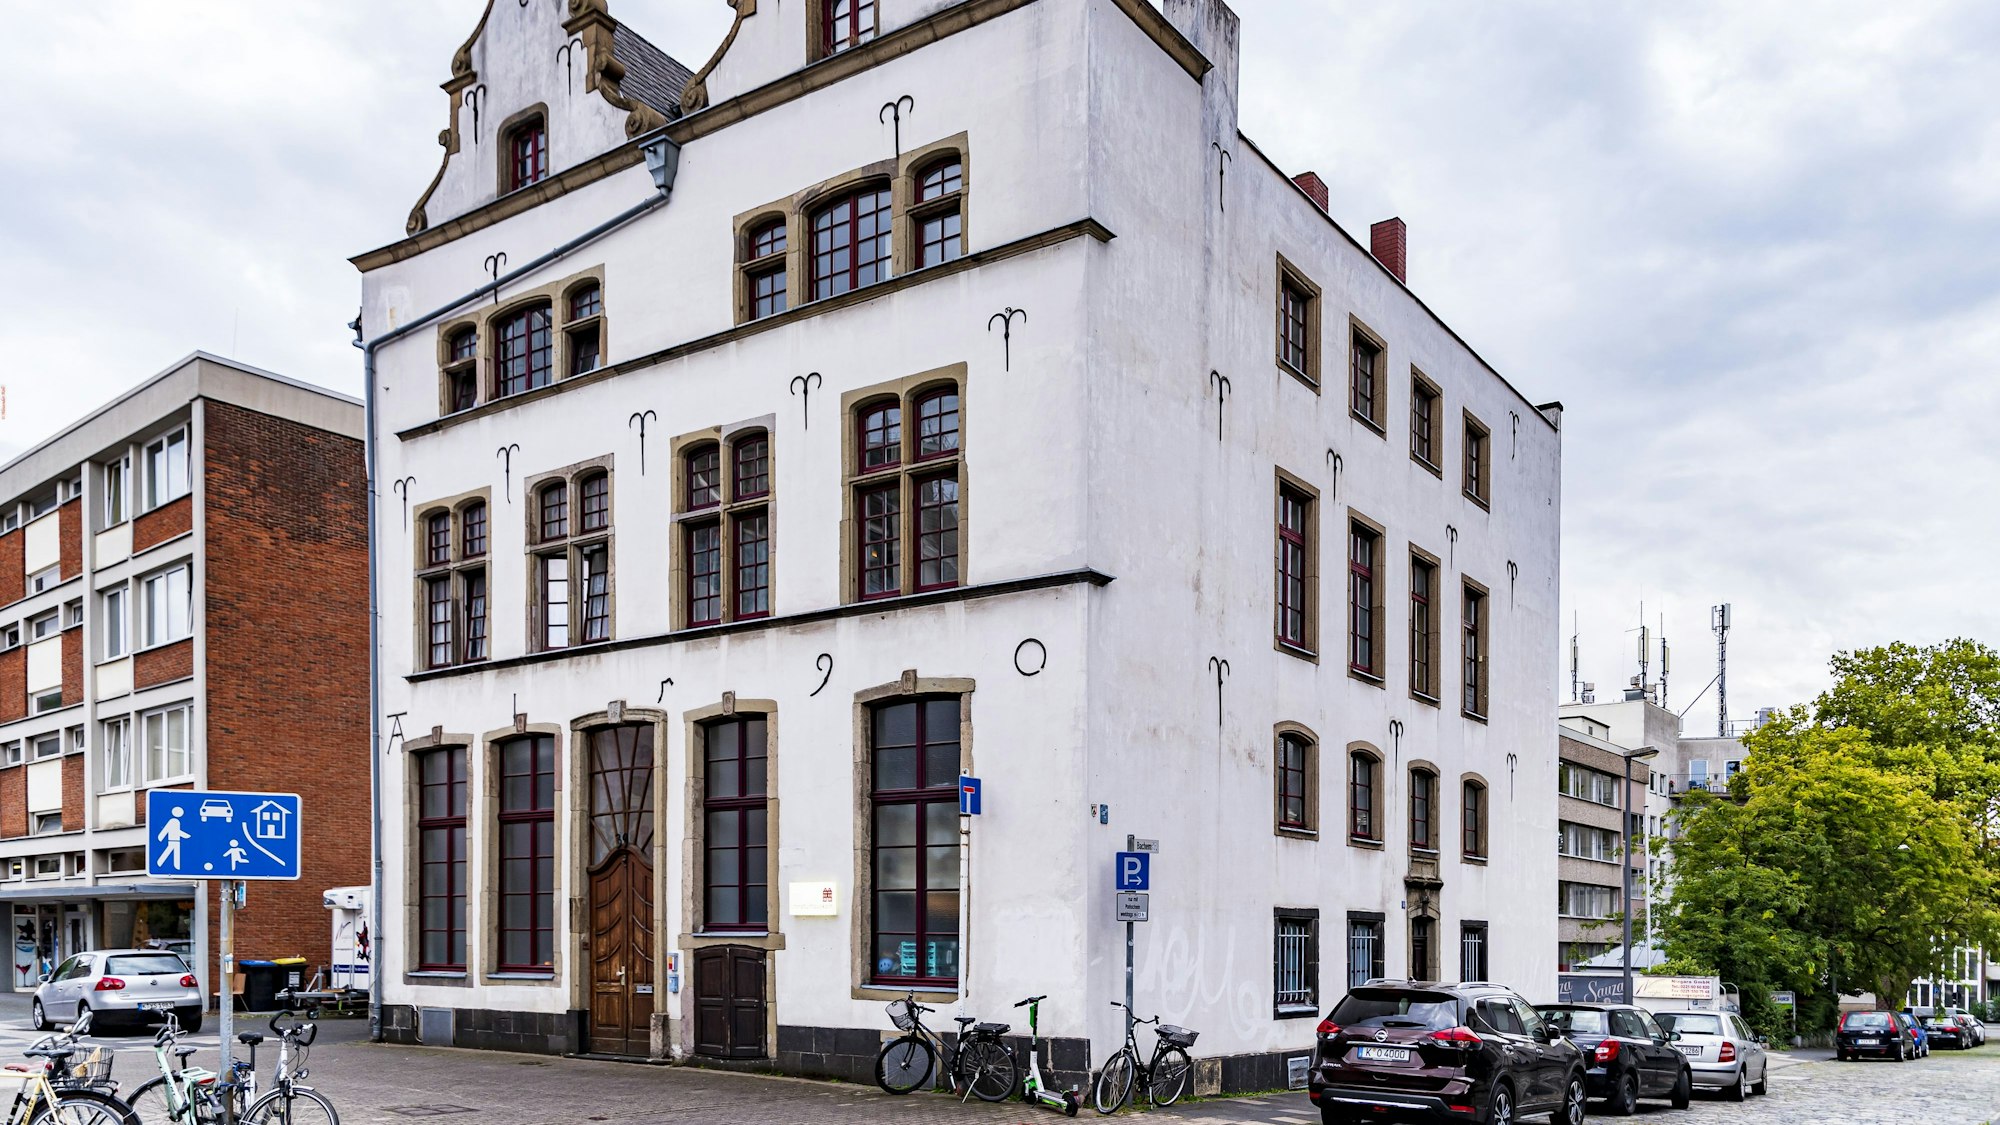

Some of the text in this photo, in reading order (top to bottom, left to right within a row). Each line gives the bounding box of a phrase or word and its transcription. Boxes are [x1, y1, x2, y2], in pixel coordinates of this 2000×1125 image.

[1123, 857, 1142, 886] P
[1583, 980, 1624, 1003] Sauza
[1365, 1048, 1372, 1057] K
[1384, 1049, 1405, 1059] 4000
